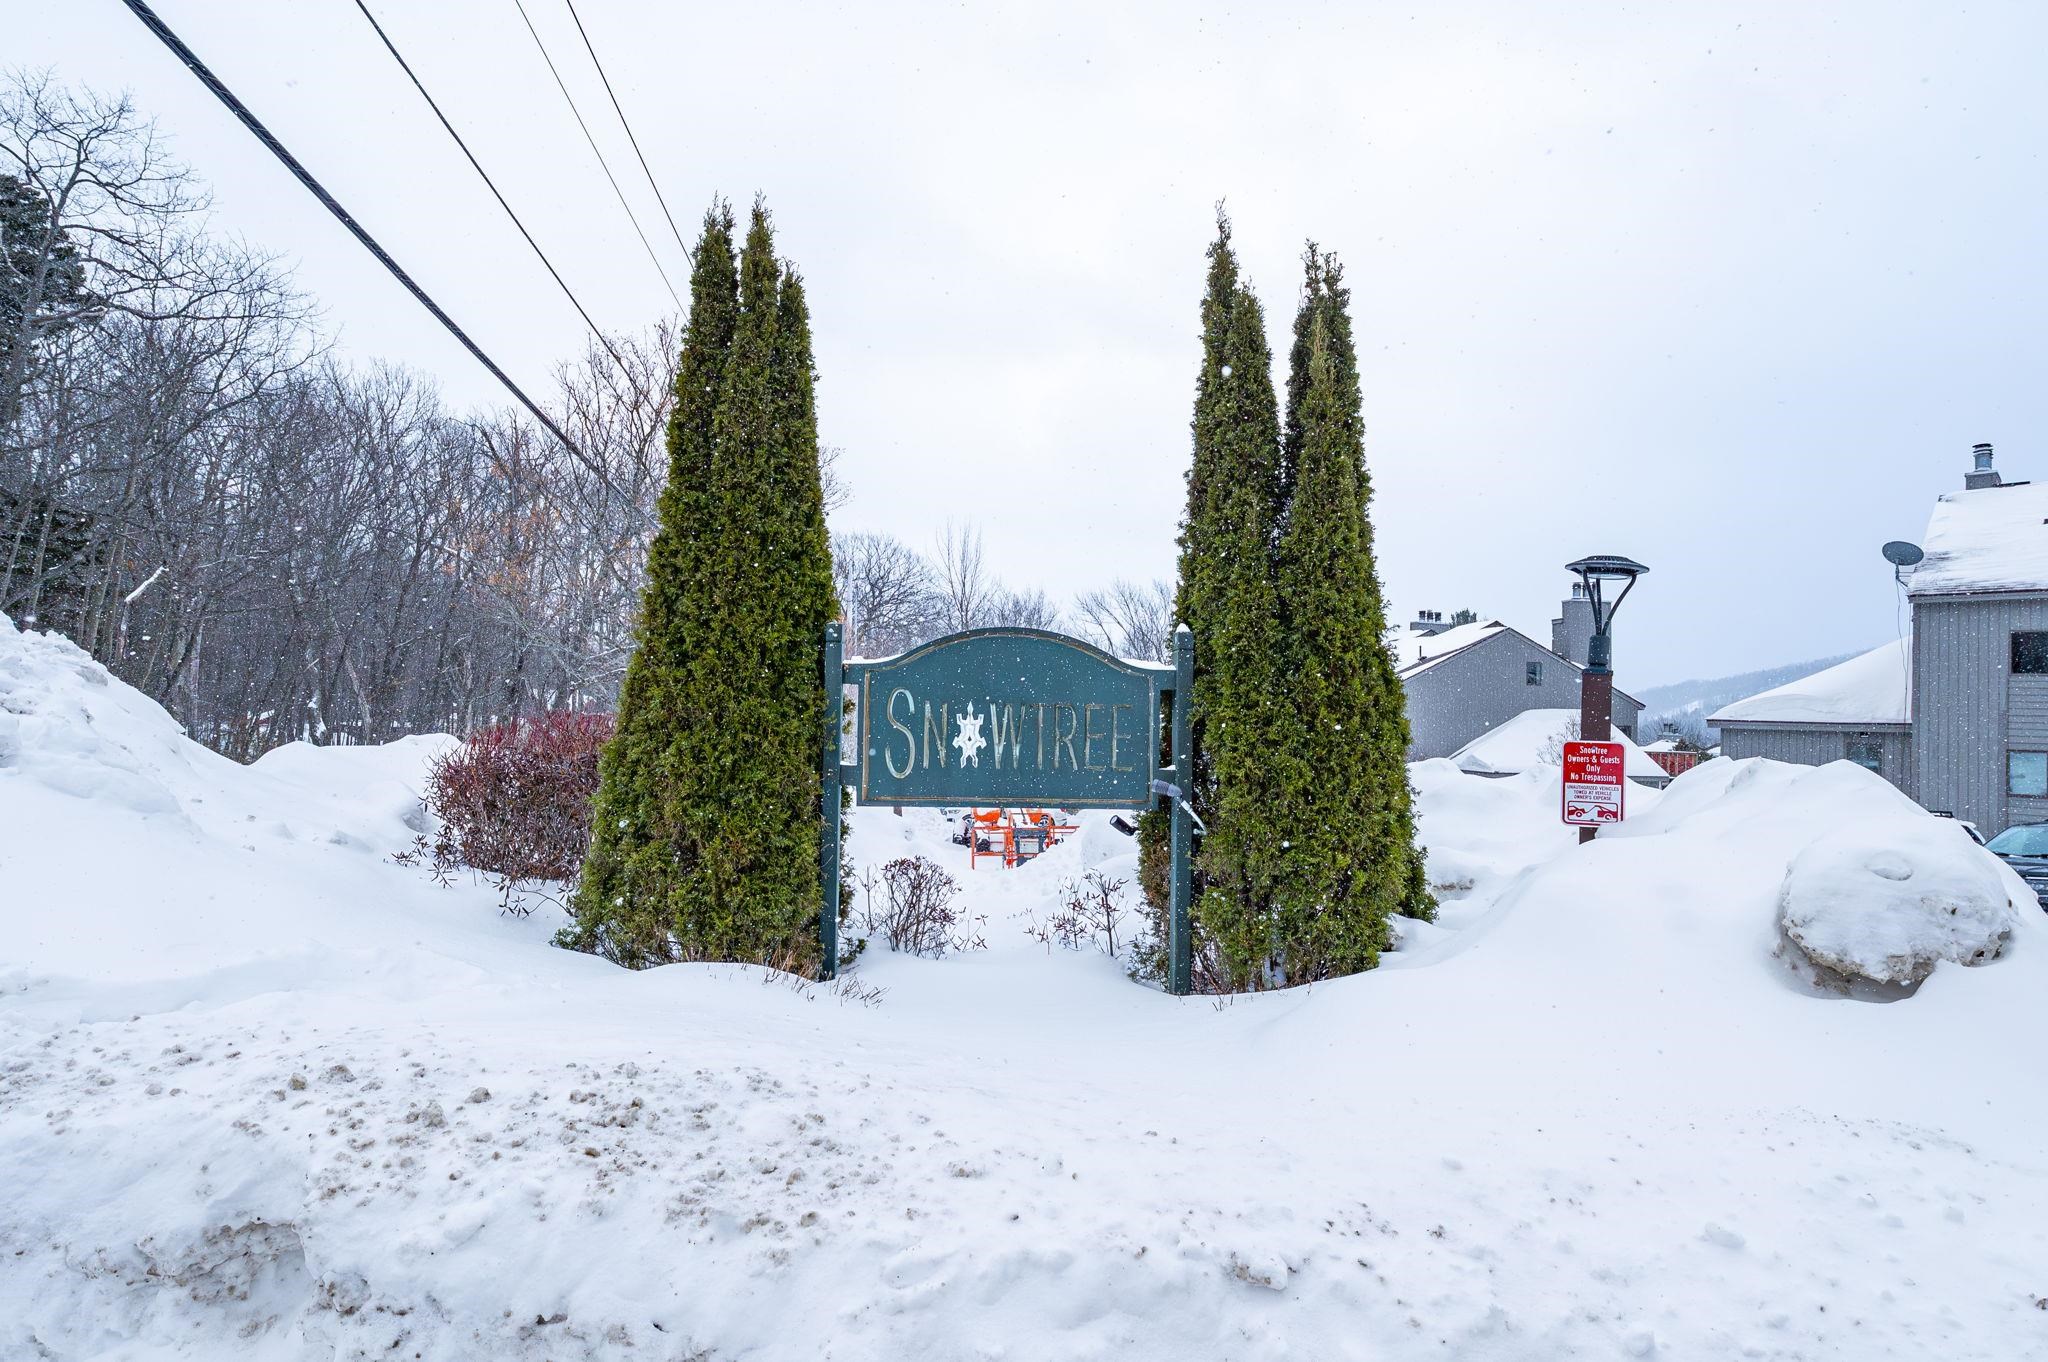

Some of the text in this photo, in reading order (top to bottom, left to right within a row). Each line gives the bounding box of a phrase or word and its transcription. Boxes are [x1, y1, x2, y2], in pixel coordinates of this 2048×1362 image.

[885, 687, 1132, 779] SNWTREE
[1580, 746, 1608, 754] Snowtree
[1568, 755, 1620, 764] Owners & Guests
[1586, 764, 1600, 773] Only
[1581, 773, 1616, 784] Trespassing
